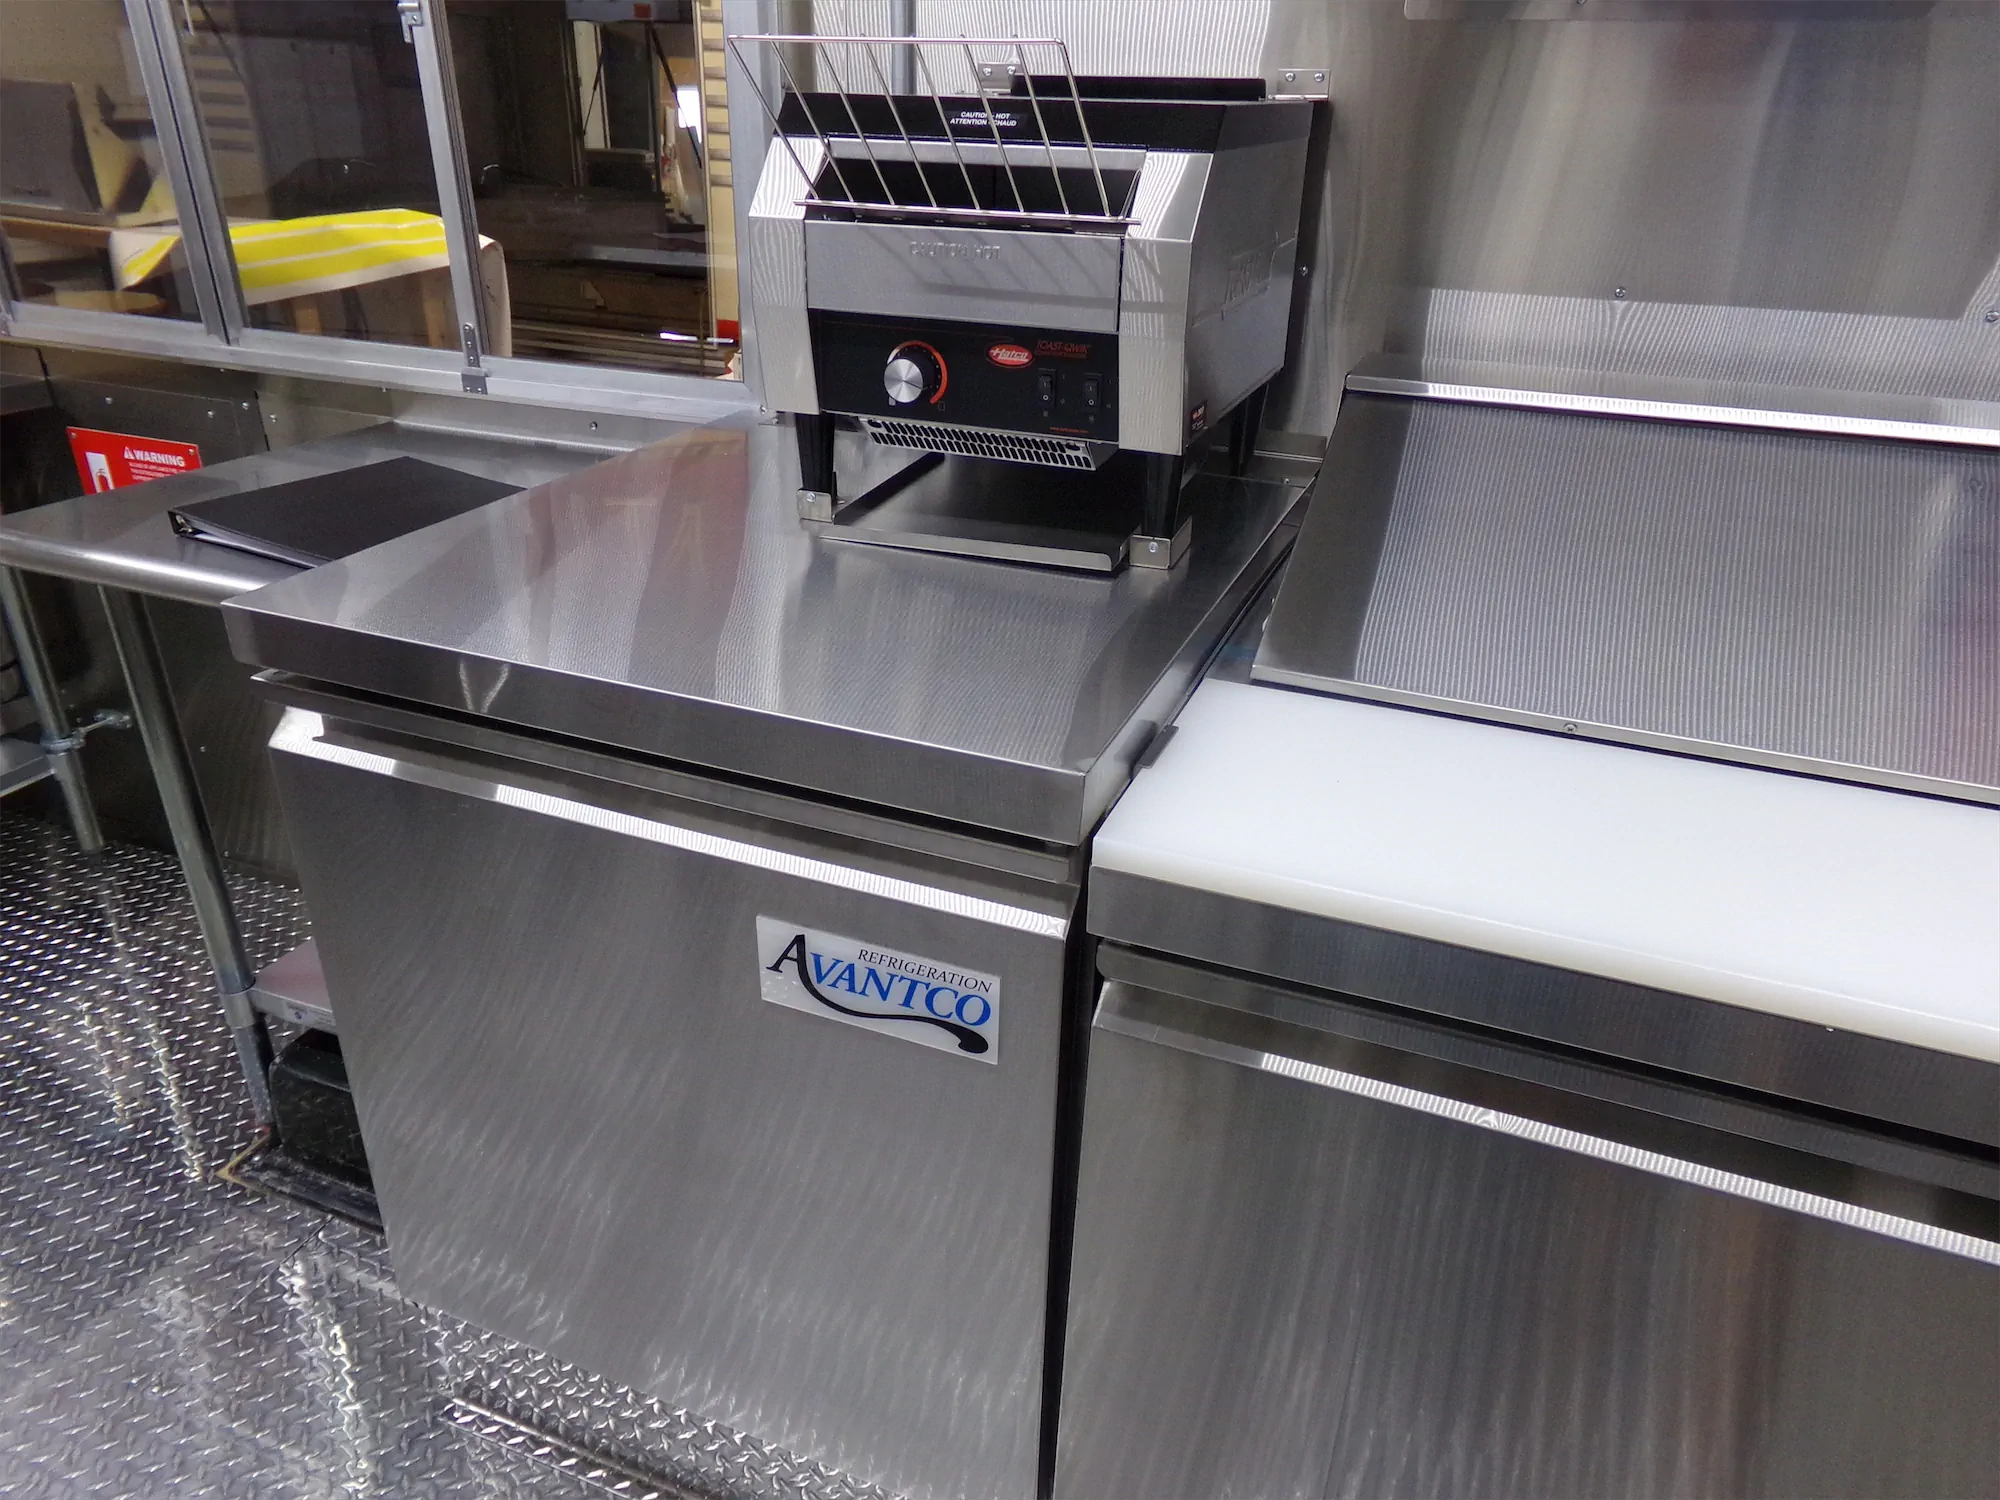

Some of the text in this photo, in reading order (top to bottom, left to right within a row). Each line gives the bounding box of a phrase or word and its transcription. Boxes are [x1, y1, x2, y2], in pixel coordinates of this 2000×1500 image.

[950, 118, 987, 126] ATTENTION
[960, 111, 988, 119] CAUTIO
[995, 112, 1011, 120] HOT
[909, 240, 1001, 260] CAUTION HOT
[989, 347, 1029, 361] Hatco
[133, 449, 185, 467] WARNING
[857, 948, 993, 994] REFRIGERATION
[766, 933, 992, 1030] AVANTCO
